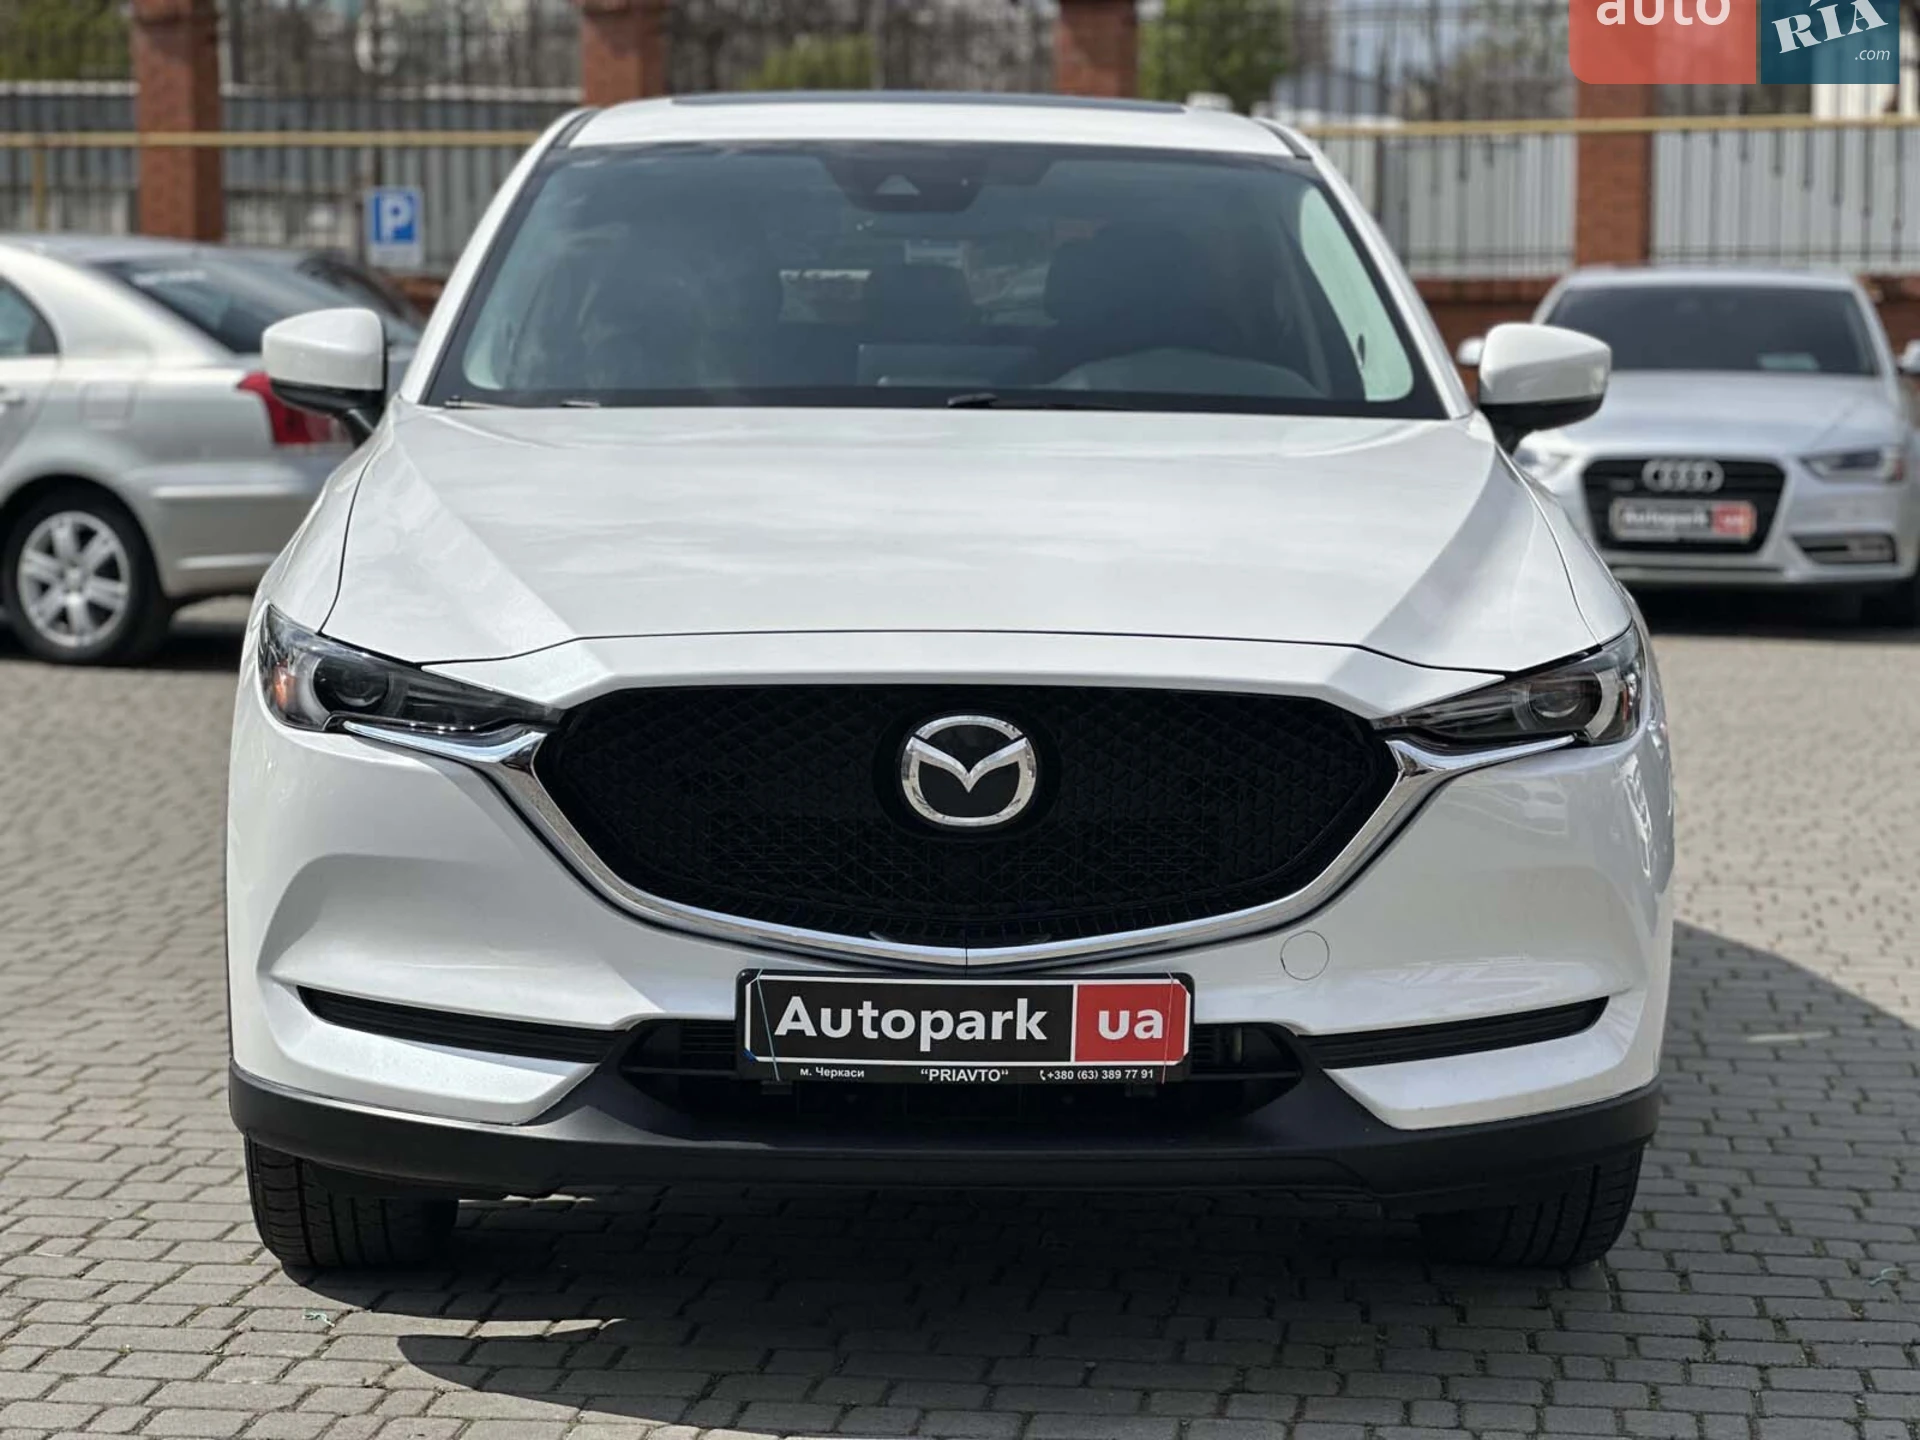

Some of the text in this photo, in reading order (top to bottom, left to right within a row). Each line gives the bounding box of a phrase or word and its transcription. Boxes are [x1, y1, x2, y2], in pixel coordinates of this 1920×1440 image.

[381, 196, 412, 239] P
[774, 996, 1164, 1052] Autopark ua
[815, 1066, 865, 1079] Черкаси
[1047, 1069, 1154, 1081] +380 (63) 389 77 91
